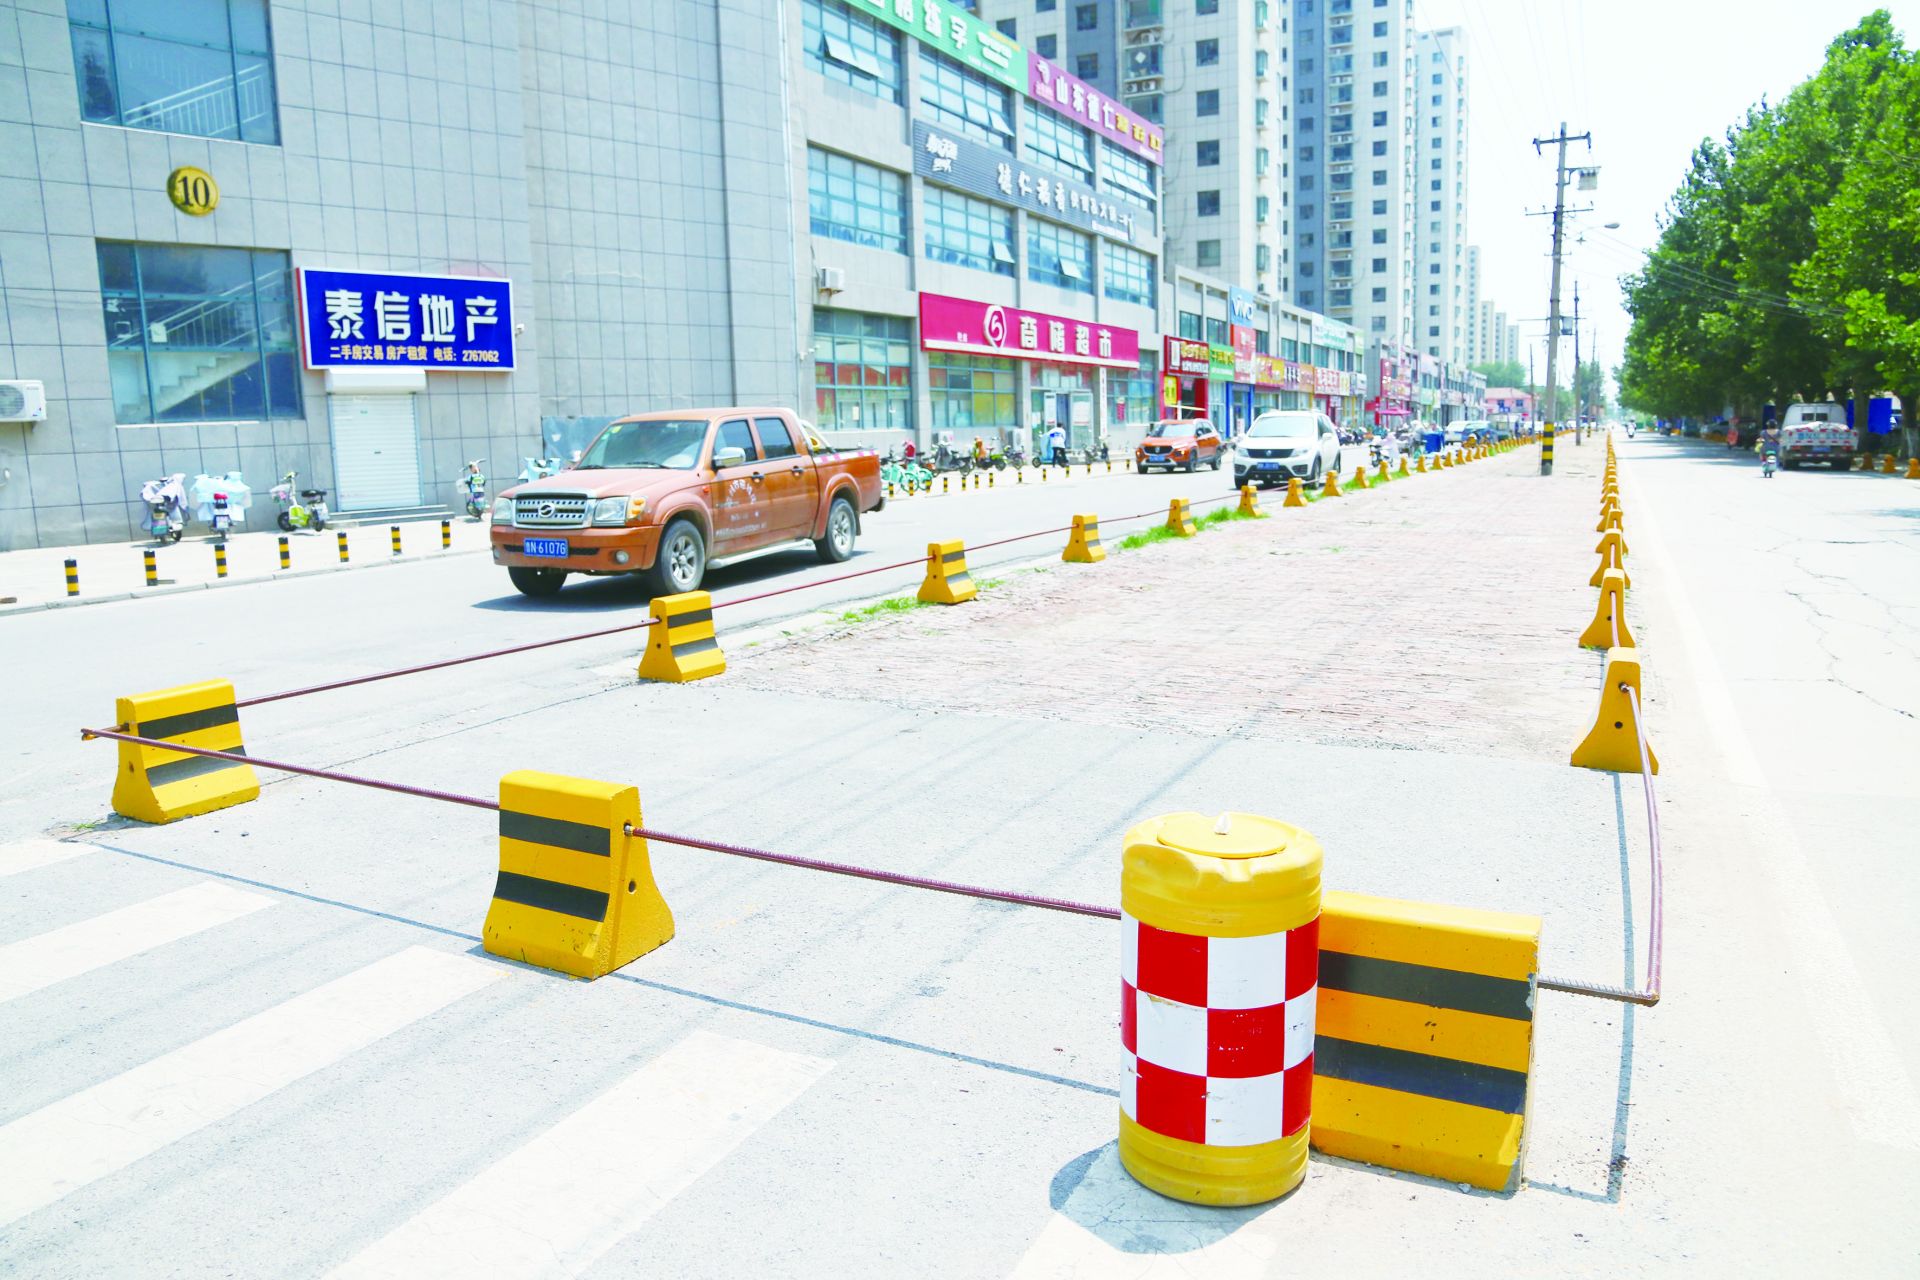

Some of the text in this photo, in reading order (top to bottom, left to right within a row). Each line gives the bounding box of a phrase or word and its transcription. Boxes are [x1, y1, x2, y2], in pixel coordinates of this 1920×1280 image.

[177, 175, 210, 208] 10
[324, 288, 499, 343] 泰信地产
[329, 344, 384, 361] 二手房交易
[386, 344, 428, 361] 房产租赁
[462, 349, 500, 363] 2767062
